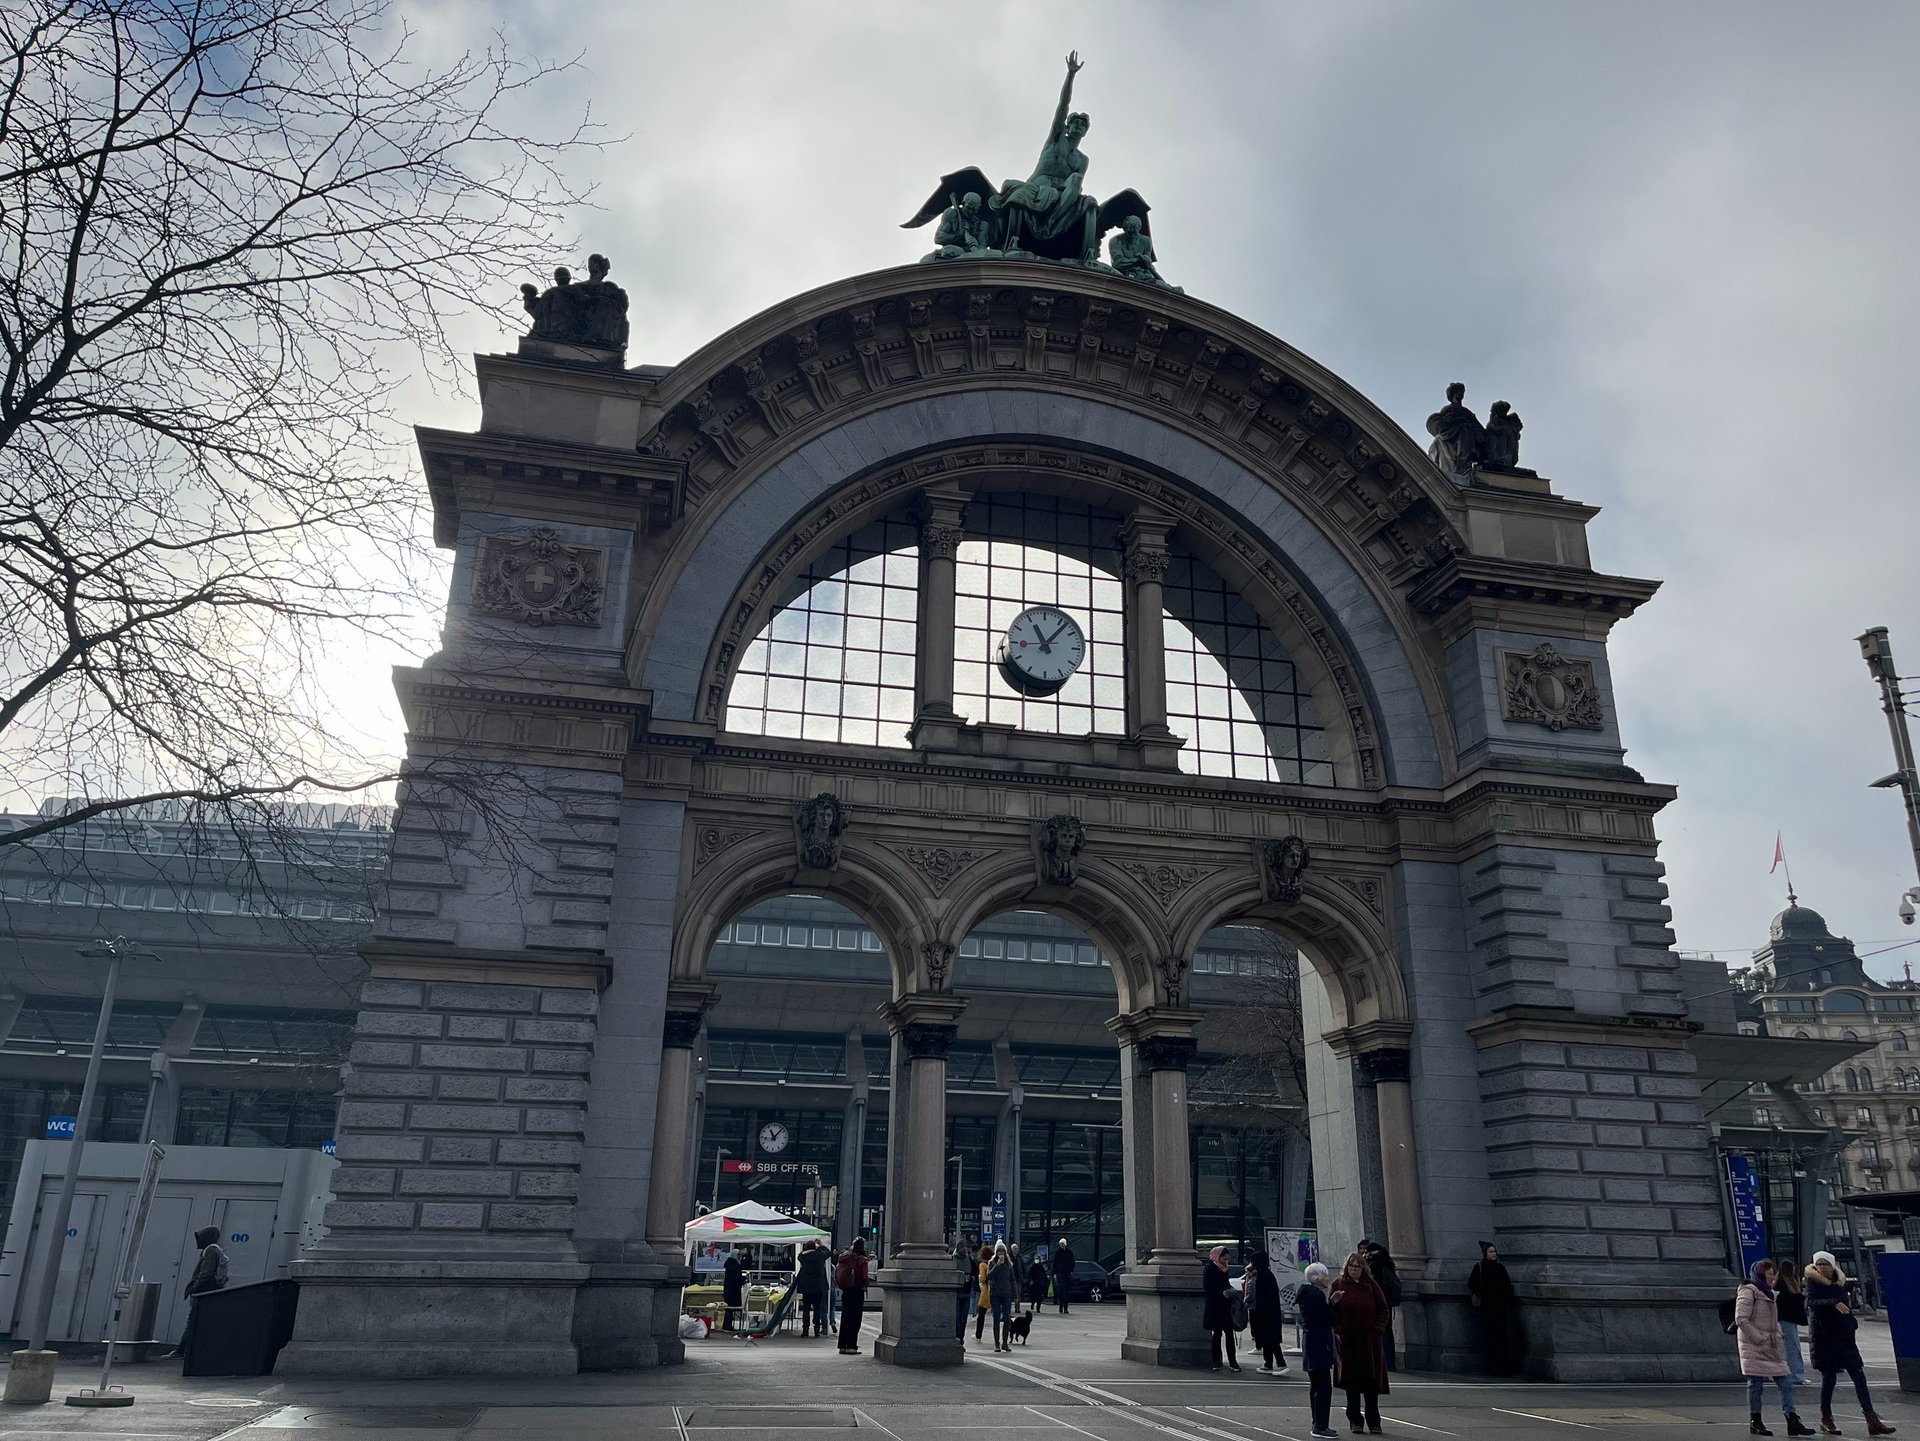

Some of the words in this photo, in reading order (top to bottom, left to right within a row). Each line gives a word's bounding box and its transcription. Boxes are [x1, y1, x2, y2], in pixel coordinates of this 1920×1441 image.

[48, 1121, 67, 1130] WC
[757, 1163, 777, 1172] SBB
[781, 1164, 798, 1172] CFF
[801, 1164, 818, 1173] FFS
